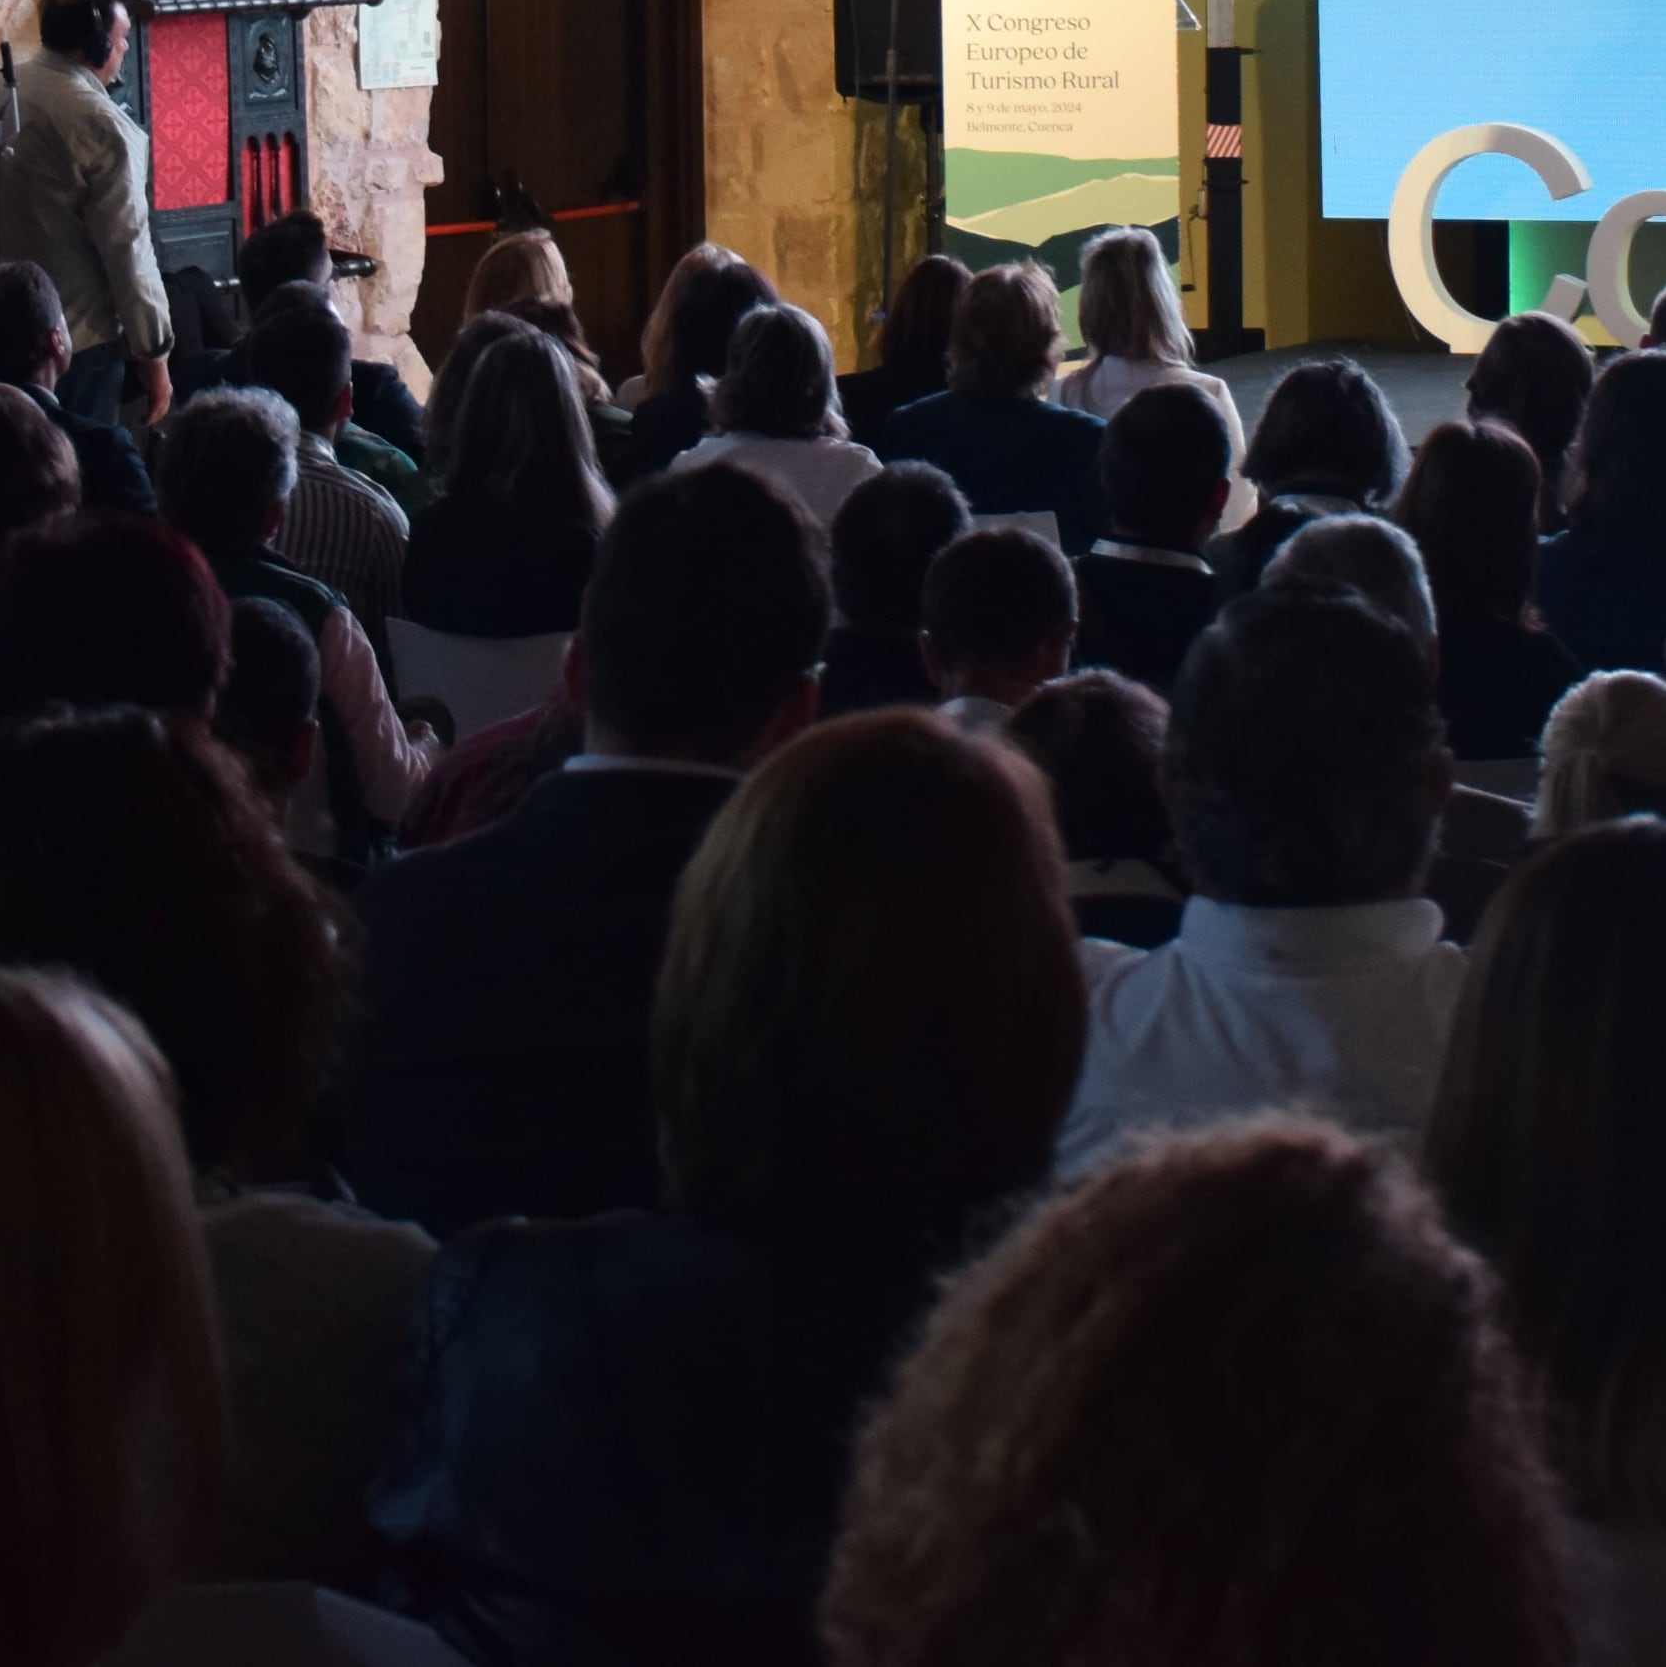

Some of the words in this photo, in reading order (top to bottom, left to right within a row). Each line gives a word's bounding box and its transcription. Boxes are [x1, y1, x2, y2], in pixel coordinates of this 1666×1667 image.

[966, 13, 982, 32] X
[987, 13, 1091, 36] Congreso
[966, 42, 1058, 65] Europeo
[1063, 41, 1089, 60] de
[967, 70, 1057, 90] Turismo
[1062, 70, 1120, 89] Rural
[997, 102, 1012, 113] de
[1051, 102, 1082, 113] 2024
[1027, 120, 1074, 133] Cuenca
